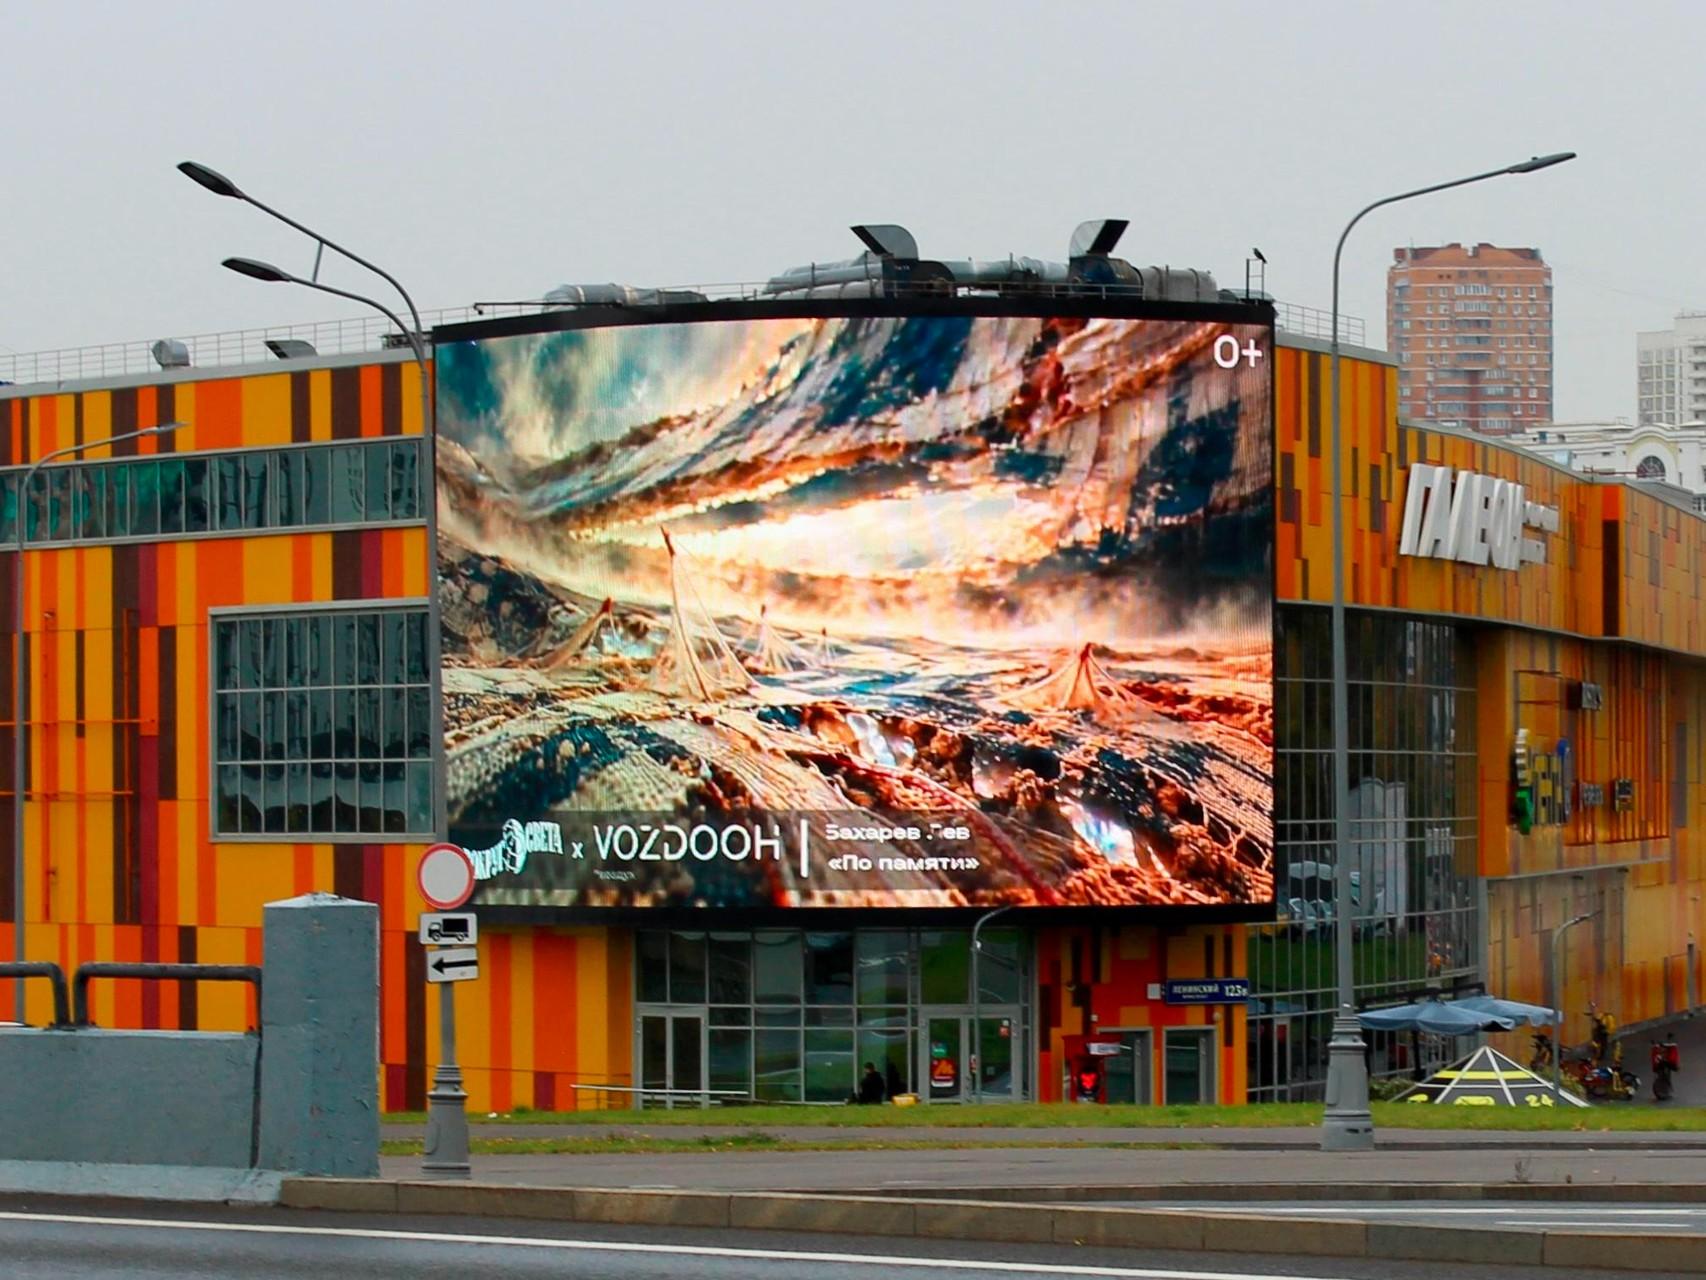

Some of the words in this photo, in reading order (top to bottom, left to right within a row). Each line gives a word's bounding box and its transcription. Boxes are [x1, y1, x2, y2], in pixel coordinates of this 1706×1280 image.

[1213, 334, 1263, 368] 0+
[593, 824, 780, 861] VOZDOOH
[828, 854, 872, 871] «По
[878, 857, 980, 871] памяти»
